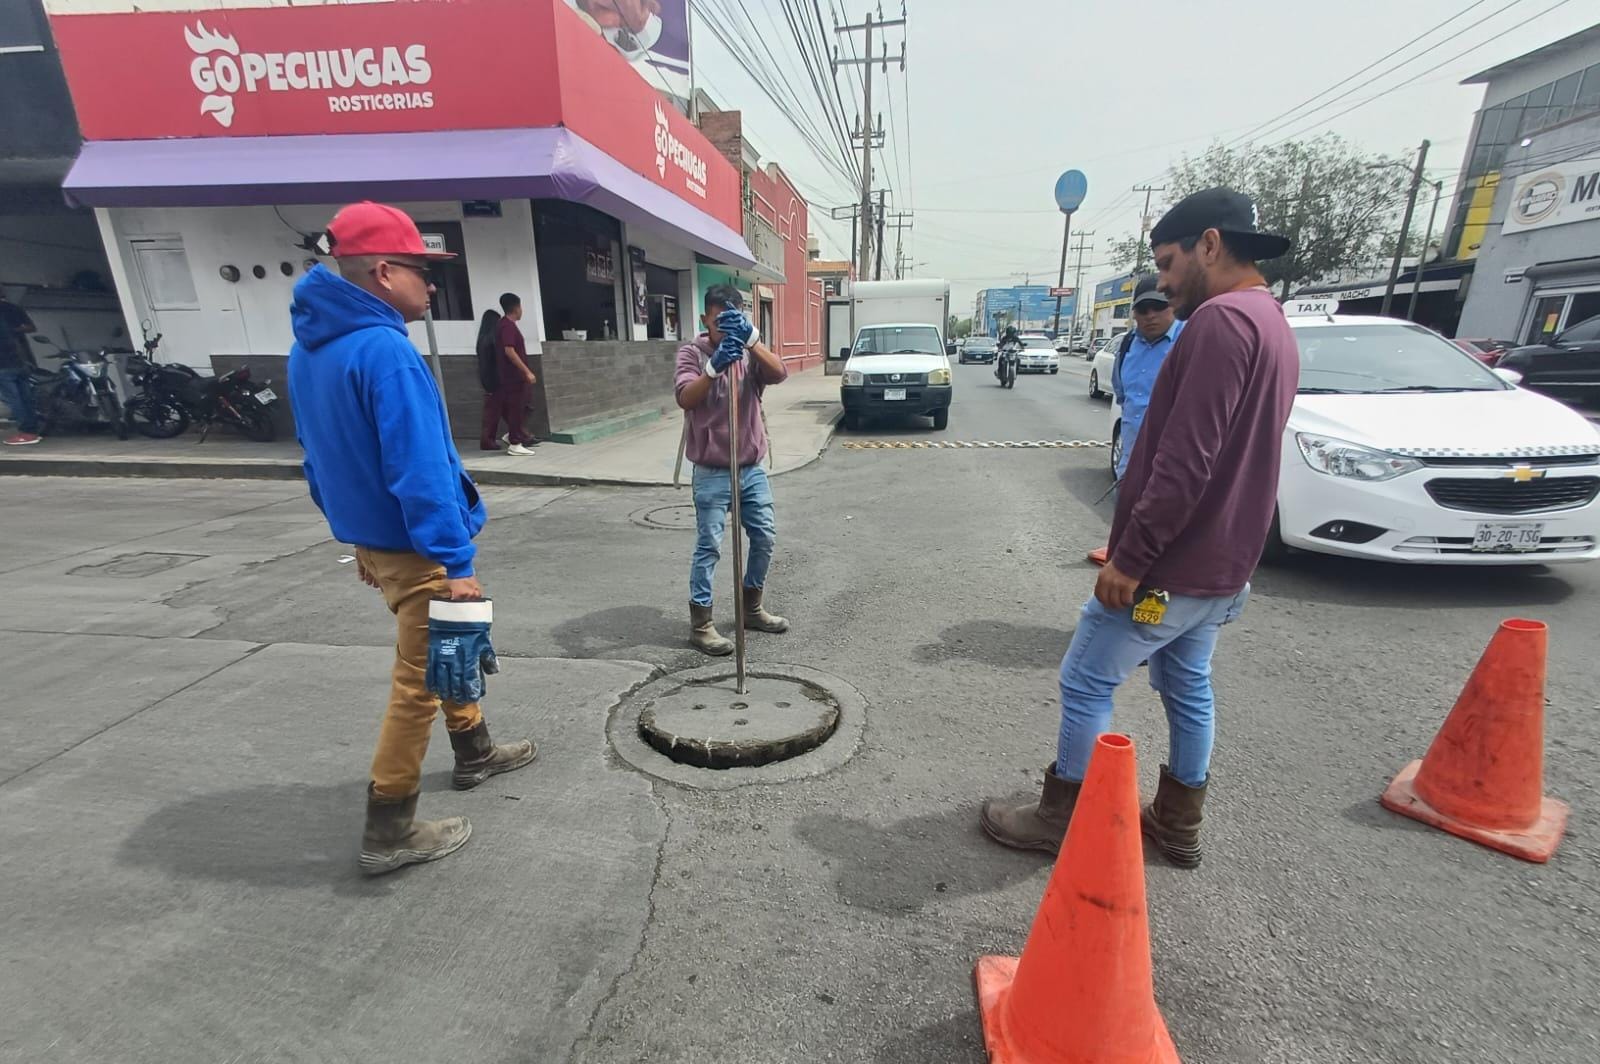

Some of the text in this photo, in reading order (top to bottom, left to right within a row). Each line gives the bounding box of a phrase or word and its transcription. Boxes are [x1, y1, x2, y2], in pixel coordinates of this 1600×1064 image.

[191, 44, 432, 93] GO PECHUGAS
[655, 124, 707, 186] GO PECHUGAS
[1569, 171, 1600, 204] M
[1341, 288, 1371, 299] NACHO
[1297, 303, 1327, 312] TAXI
[1477, 530, 1541, 543] 30-20-TSG
[1135, 611, 1160, 624] 5529
